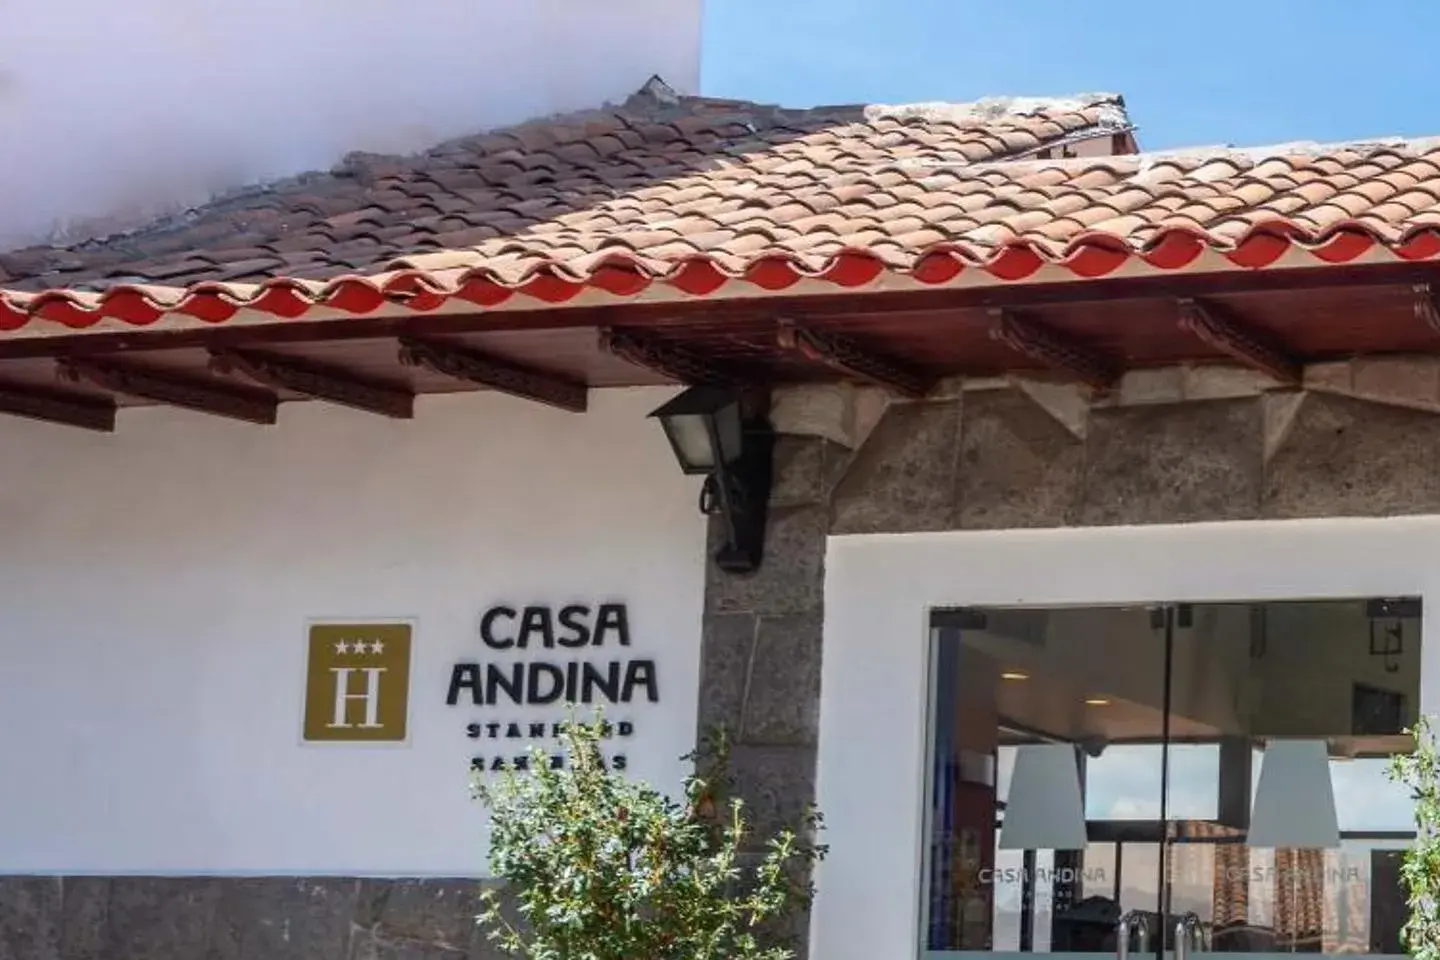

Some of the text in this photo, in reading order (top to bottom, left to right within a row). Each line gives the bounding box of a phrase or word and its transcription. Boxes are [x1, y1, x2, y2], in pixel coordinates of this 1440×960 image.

[479, 603, 631, 649] CASA
[326, 667, 388, 729] H
[445, 659, 660, 706] ANDINA
[466, 721, 634, 739] STAND
[977, 866, 1029, 884] CASA
